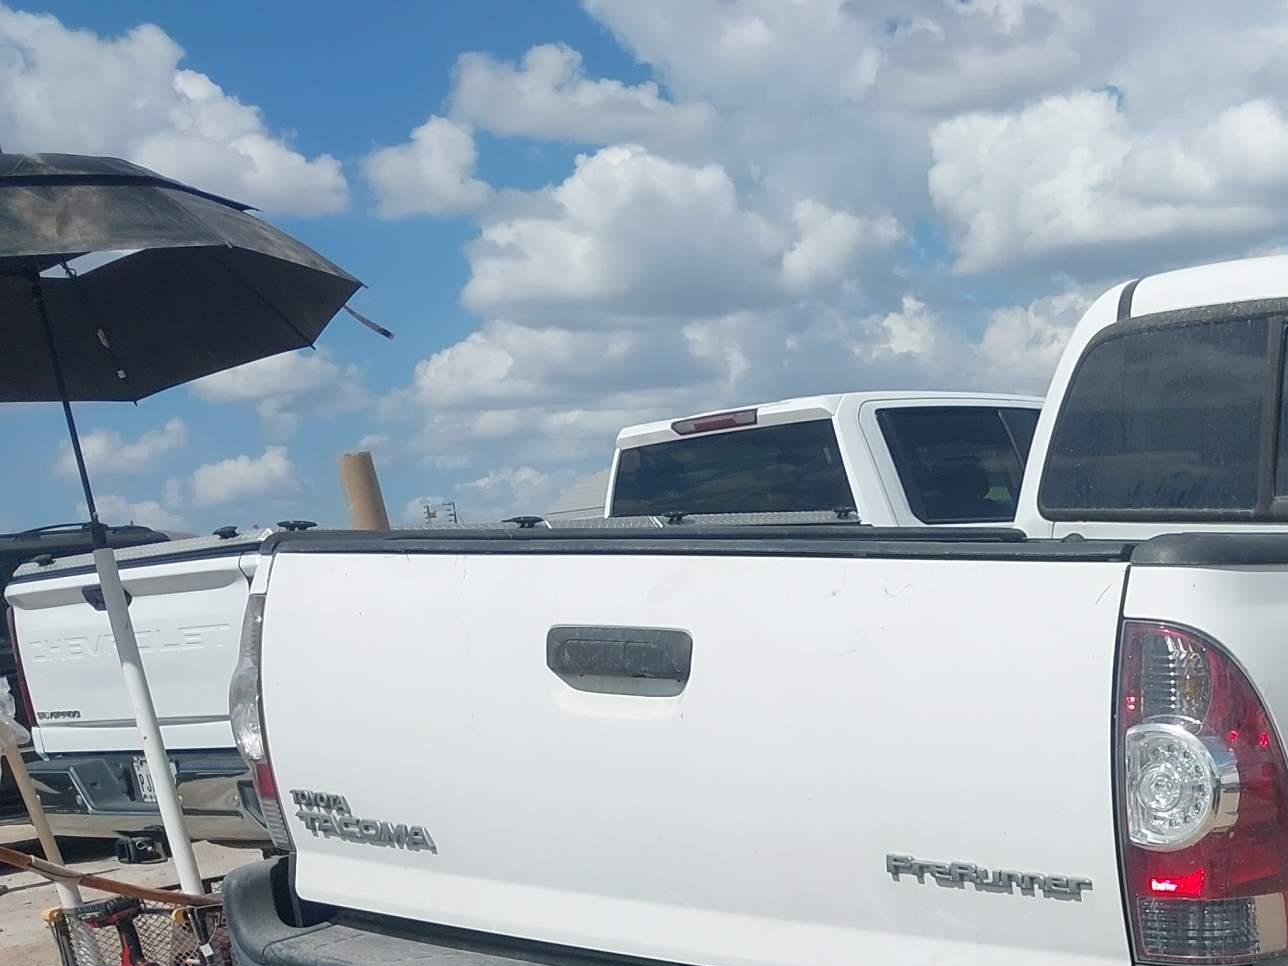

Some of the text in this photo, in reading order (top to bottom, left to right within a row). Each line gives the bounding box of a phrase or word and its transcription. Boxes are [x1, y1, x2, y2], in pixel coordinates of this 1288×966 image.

[289, 789, 353, 818] TOYOTA
[295, 811, 438, 854] TACOMA
[886, 853, 1093, 902] PreRunner
